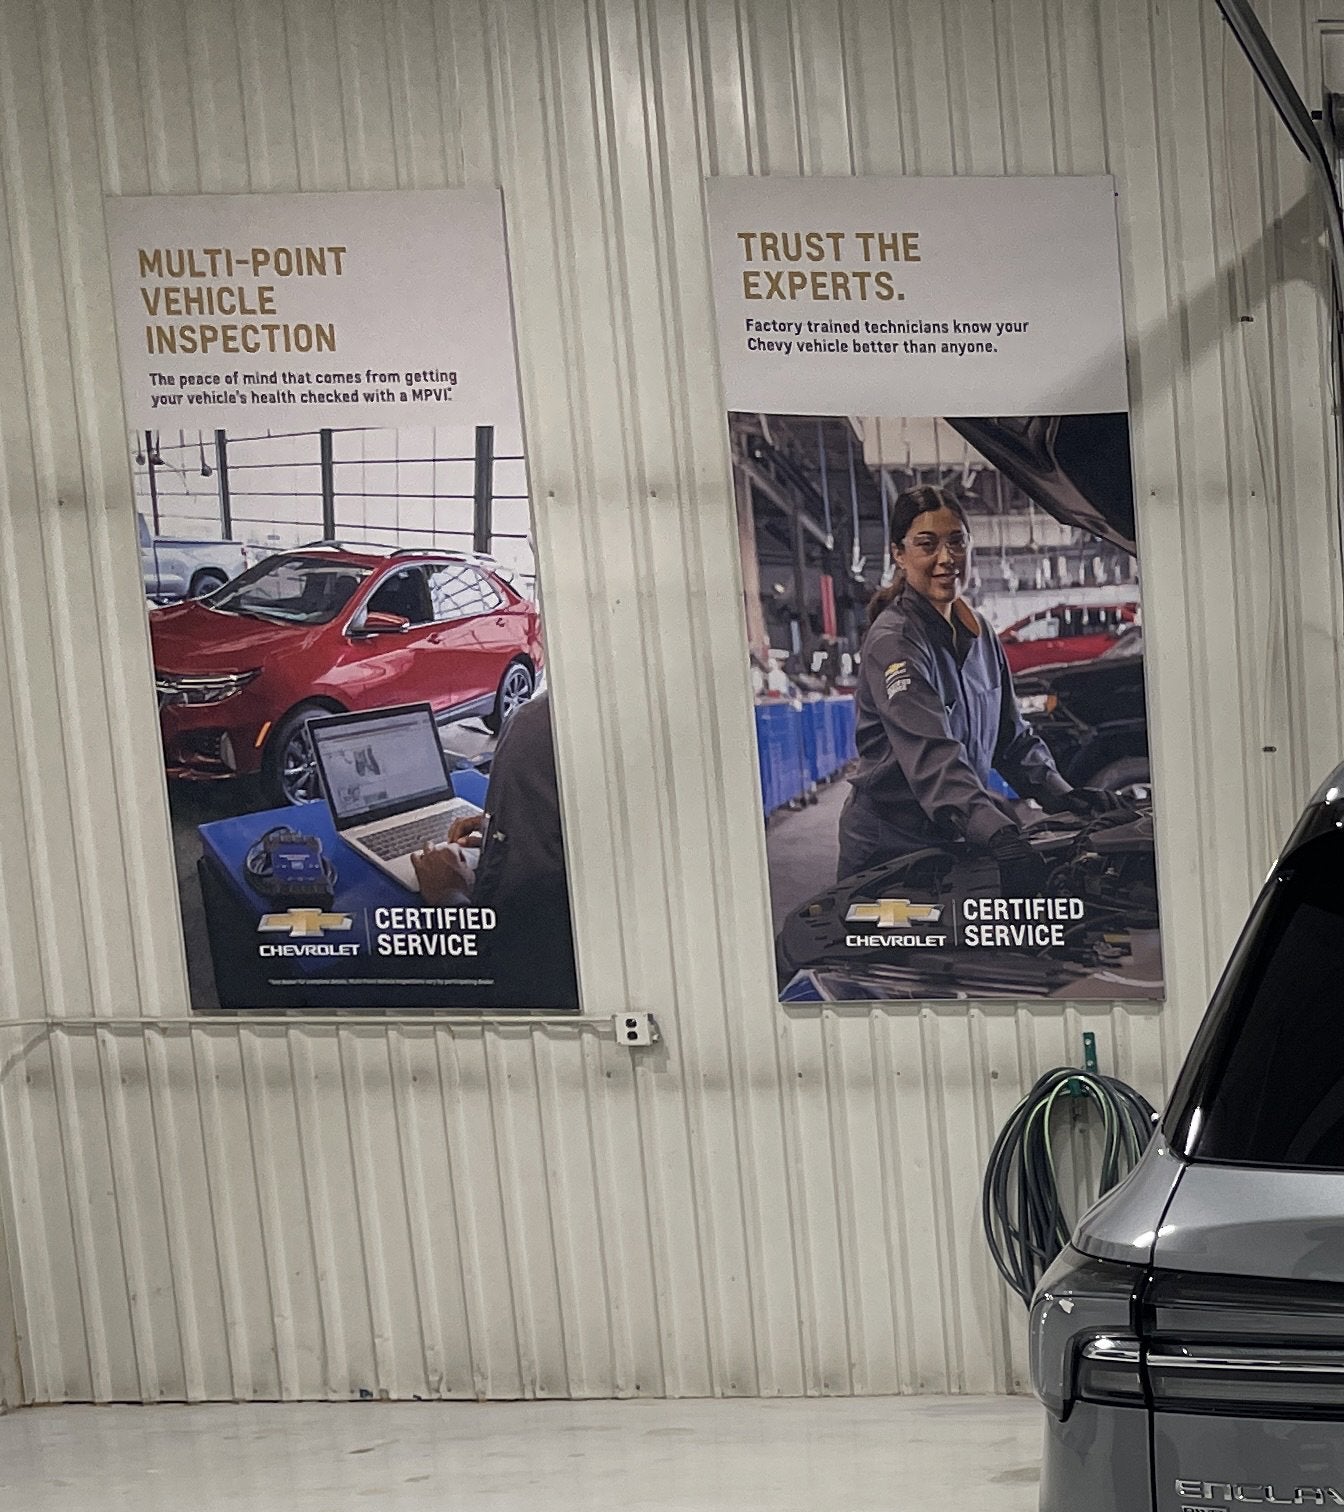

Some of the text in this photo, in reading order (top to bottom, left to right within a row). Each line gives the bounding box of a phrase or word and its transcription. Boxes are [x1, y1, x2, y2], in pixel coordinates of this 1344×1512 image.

[738, 232, 921, 262] TRUST THE
[138, 246, 347, 279] MULTI-POINT
[742, 271, 906, 301] EXPERTS.
[141, 286, 277, 316] VEHICLE
[145, 323, 337, 354] INSPECTION
[746, 319, 1029, 336] Factory trained technicians know your
[747, 337, 998, 356] Chevy vehicle better than anyone.
[149, 369, 458, 390] The peace of mind that comes from getting
[151, 394, 183, 408] your
[187, 390, 247, 404] vehicle's
[252, 389, 296, 404] health
[301, 389, 359, 403] checked
[363, 388, 395, 402] with
[400, 391, 408, 402] a
[375, 908, 496, 930] CERTIFIED
[963, 898, 1084, 920] CERTIFIED
[377, 934, 478, 956] SERVICE
[846, 935, 946, 947] CHEVROLET
[964, 925, 1065, 947] SERVICE
[259, 943, 360, 957] CHEVROLET
